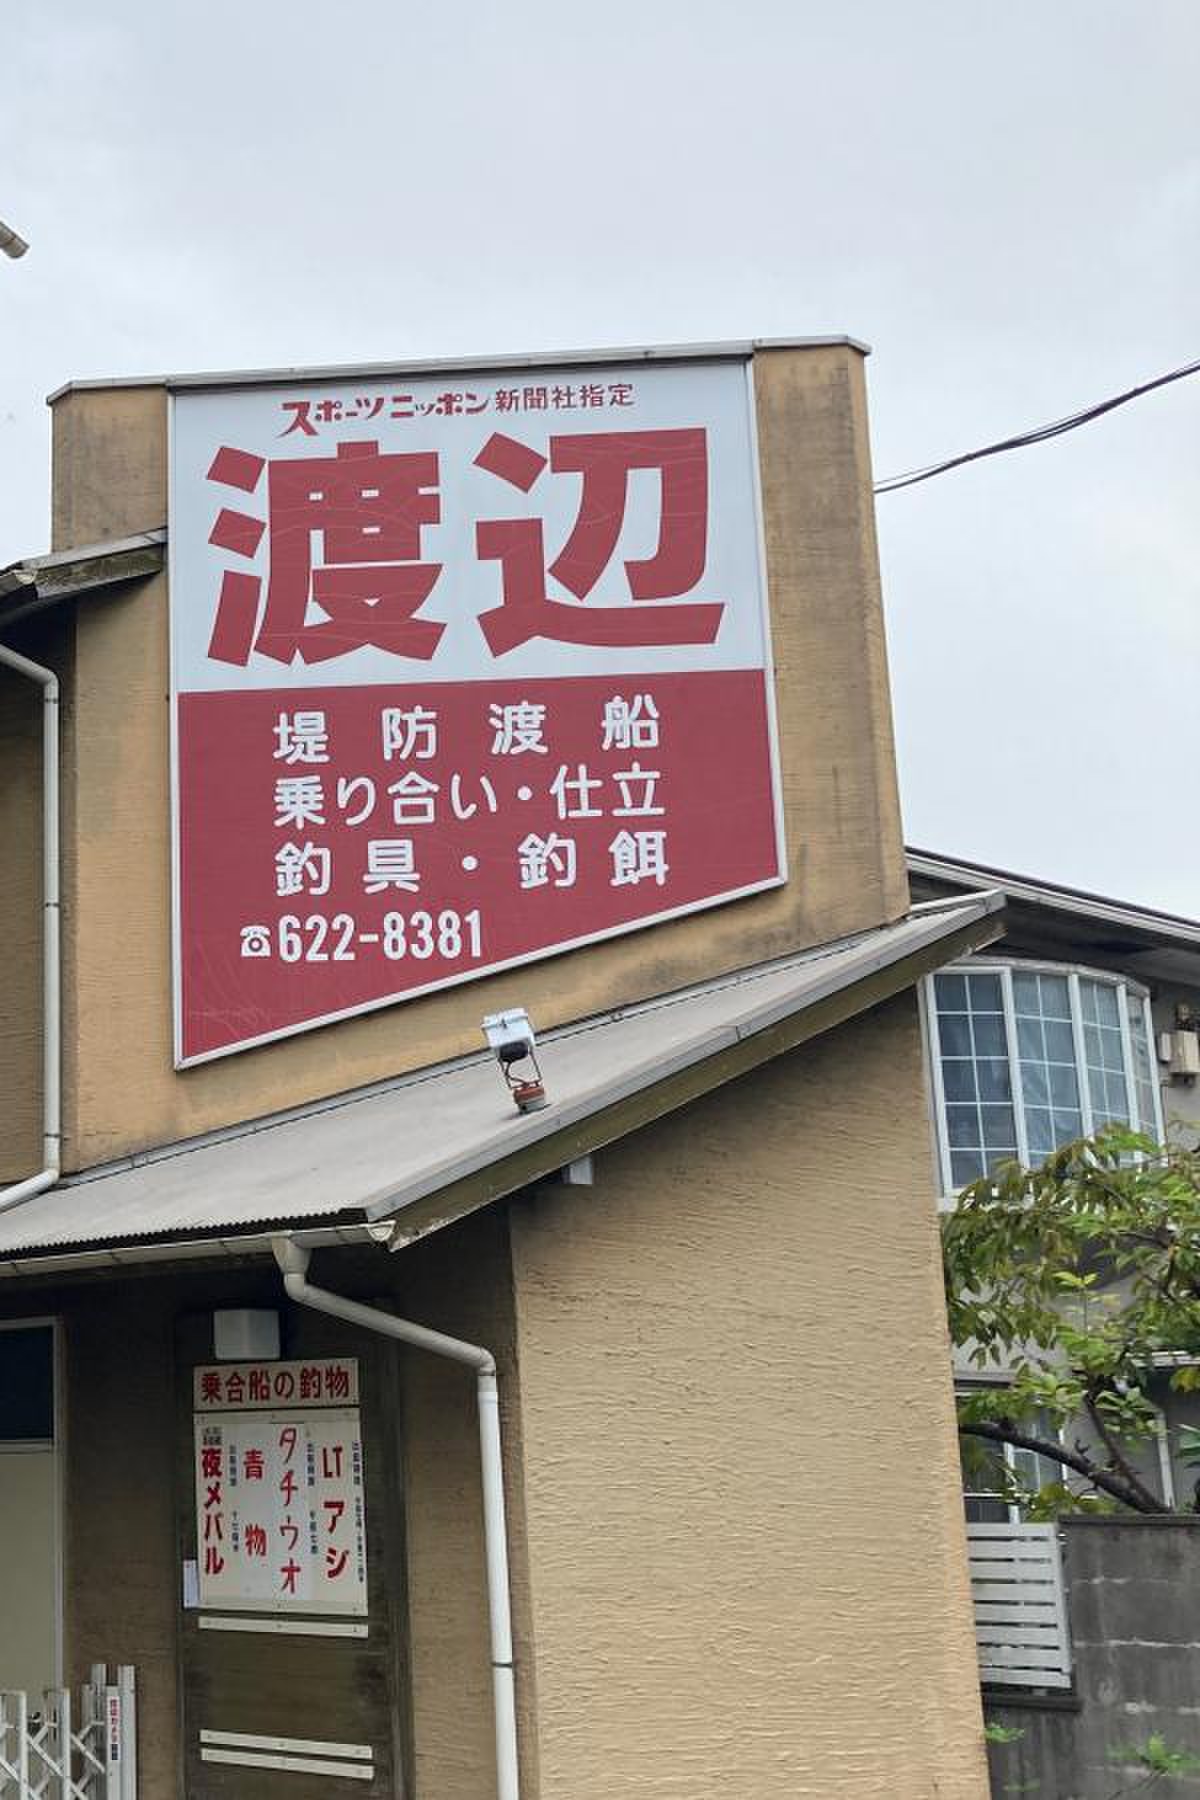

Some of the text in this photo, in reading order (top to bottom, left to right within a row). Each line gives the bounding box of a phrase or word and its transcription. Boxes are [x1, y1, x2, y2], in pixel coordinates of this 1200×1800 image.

[207, 427, 725, 667] 渡辺
[273, 695, 661, 765] 堤防渡船
[273, 763, 666, 829] 乗り合い・仕立
[275, 830, 669, 897] 釣具・釣餌
[277, 909, 483, 963] 622-8381
[201, 1367, 350, 1404] 乗合船の釣物
[201, 1447, 226, 1576] 夜メバル
[243, 1449, 268, 1557] 青物
[279, 1427, 301, 1595] タチウオ
